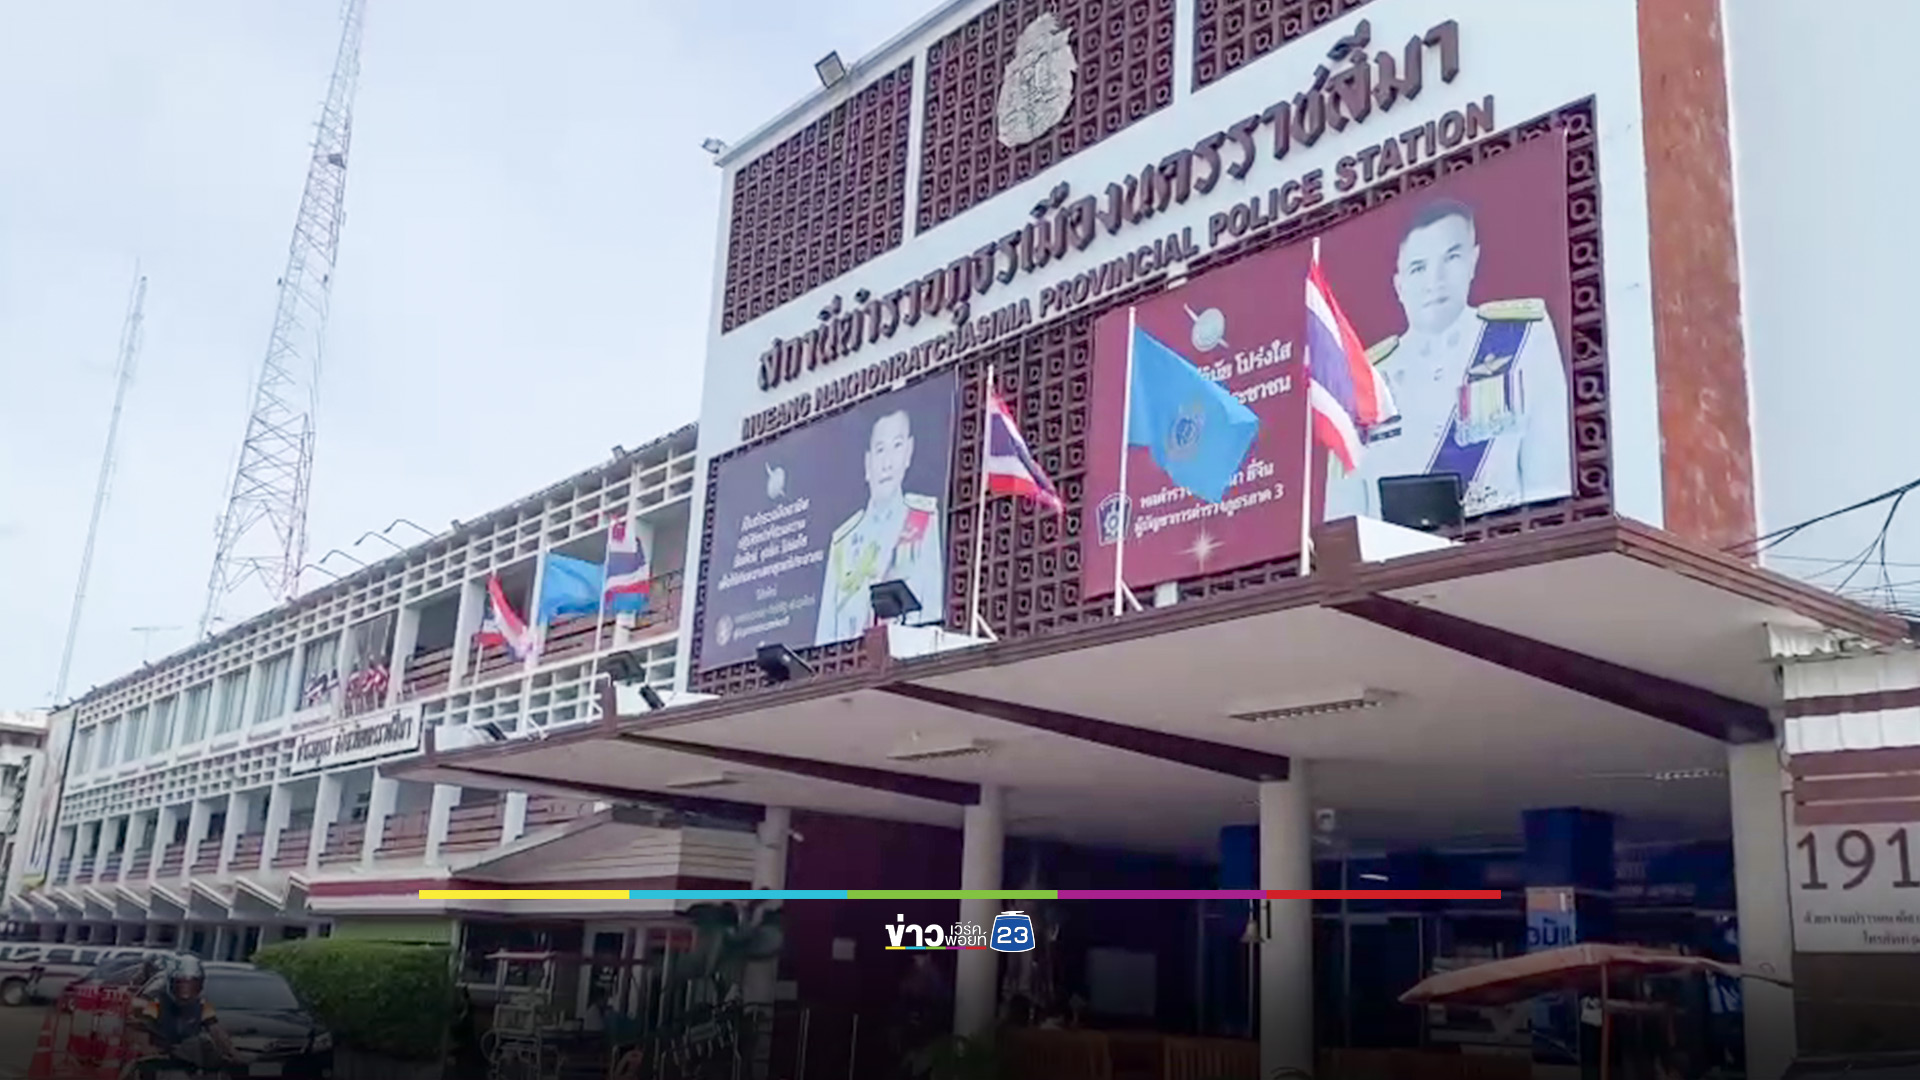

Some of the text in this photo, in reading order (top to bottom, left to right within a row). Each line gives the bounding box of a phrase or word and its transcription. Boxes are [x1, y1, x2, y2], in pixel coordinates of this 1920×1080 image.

[741, 95, 1495, 442] MUEANG NAKHONRATCHASIMA PROVINCIAL POLICE STATION
[1274, 483, 1285, 499] 3
[1797, 827, 1920, 890] 191
